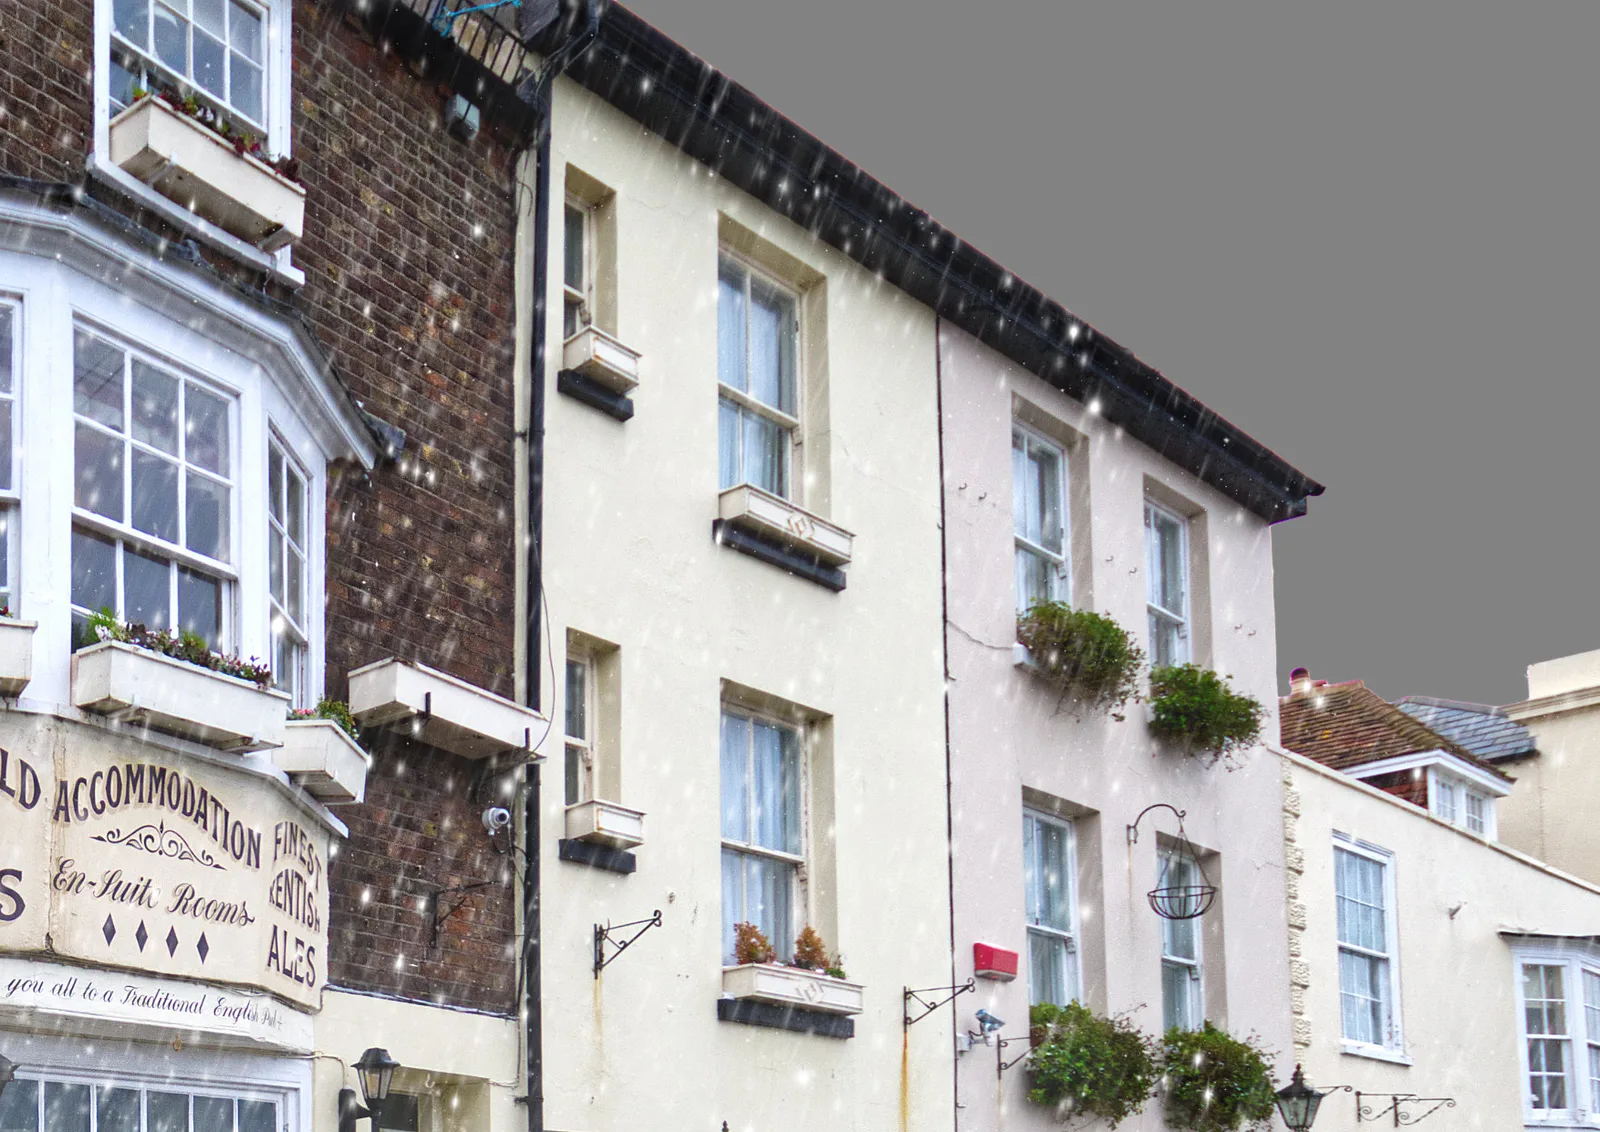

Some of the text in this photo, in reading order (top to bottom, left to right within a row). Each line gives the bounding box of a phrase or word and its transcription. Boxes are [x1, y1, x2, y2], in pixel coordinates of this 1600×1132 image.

[53, 763, 261, 869] ACCOMMODATION
[274, 821, 322, 894] FINEST
[167, 883, 255, 926] Rooms
[269, 869, 321, 932] KENTISH
[267, 925, 316, 987] ALES
[6, 978, 44, 997] you
[51, 976, 76, 998] all
[83, 982, 98, 999] to
[104, 990, 114, 1002] a
[121, 985, 206, 1014] Traditional
